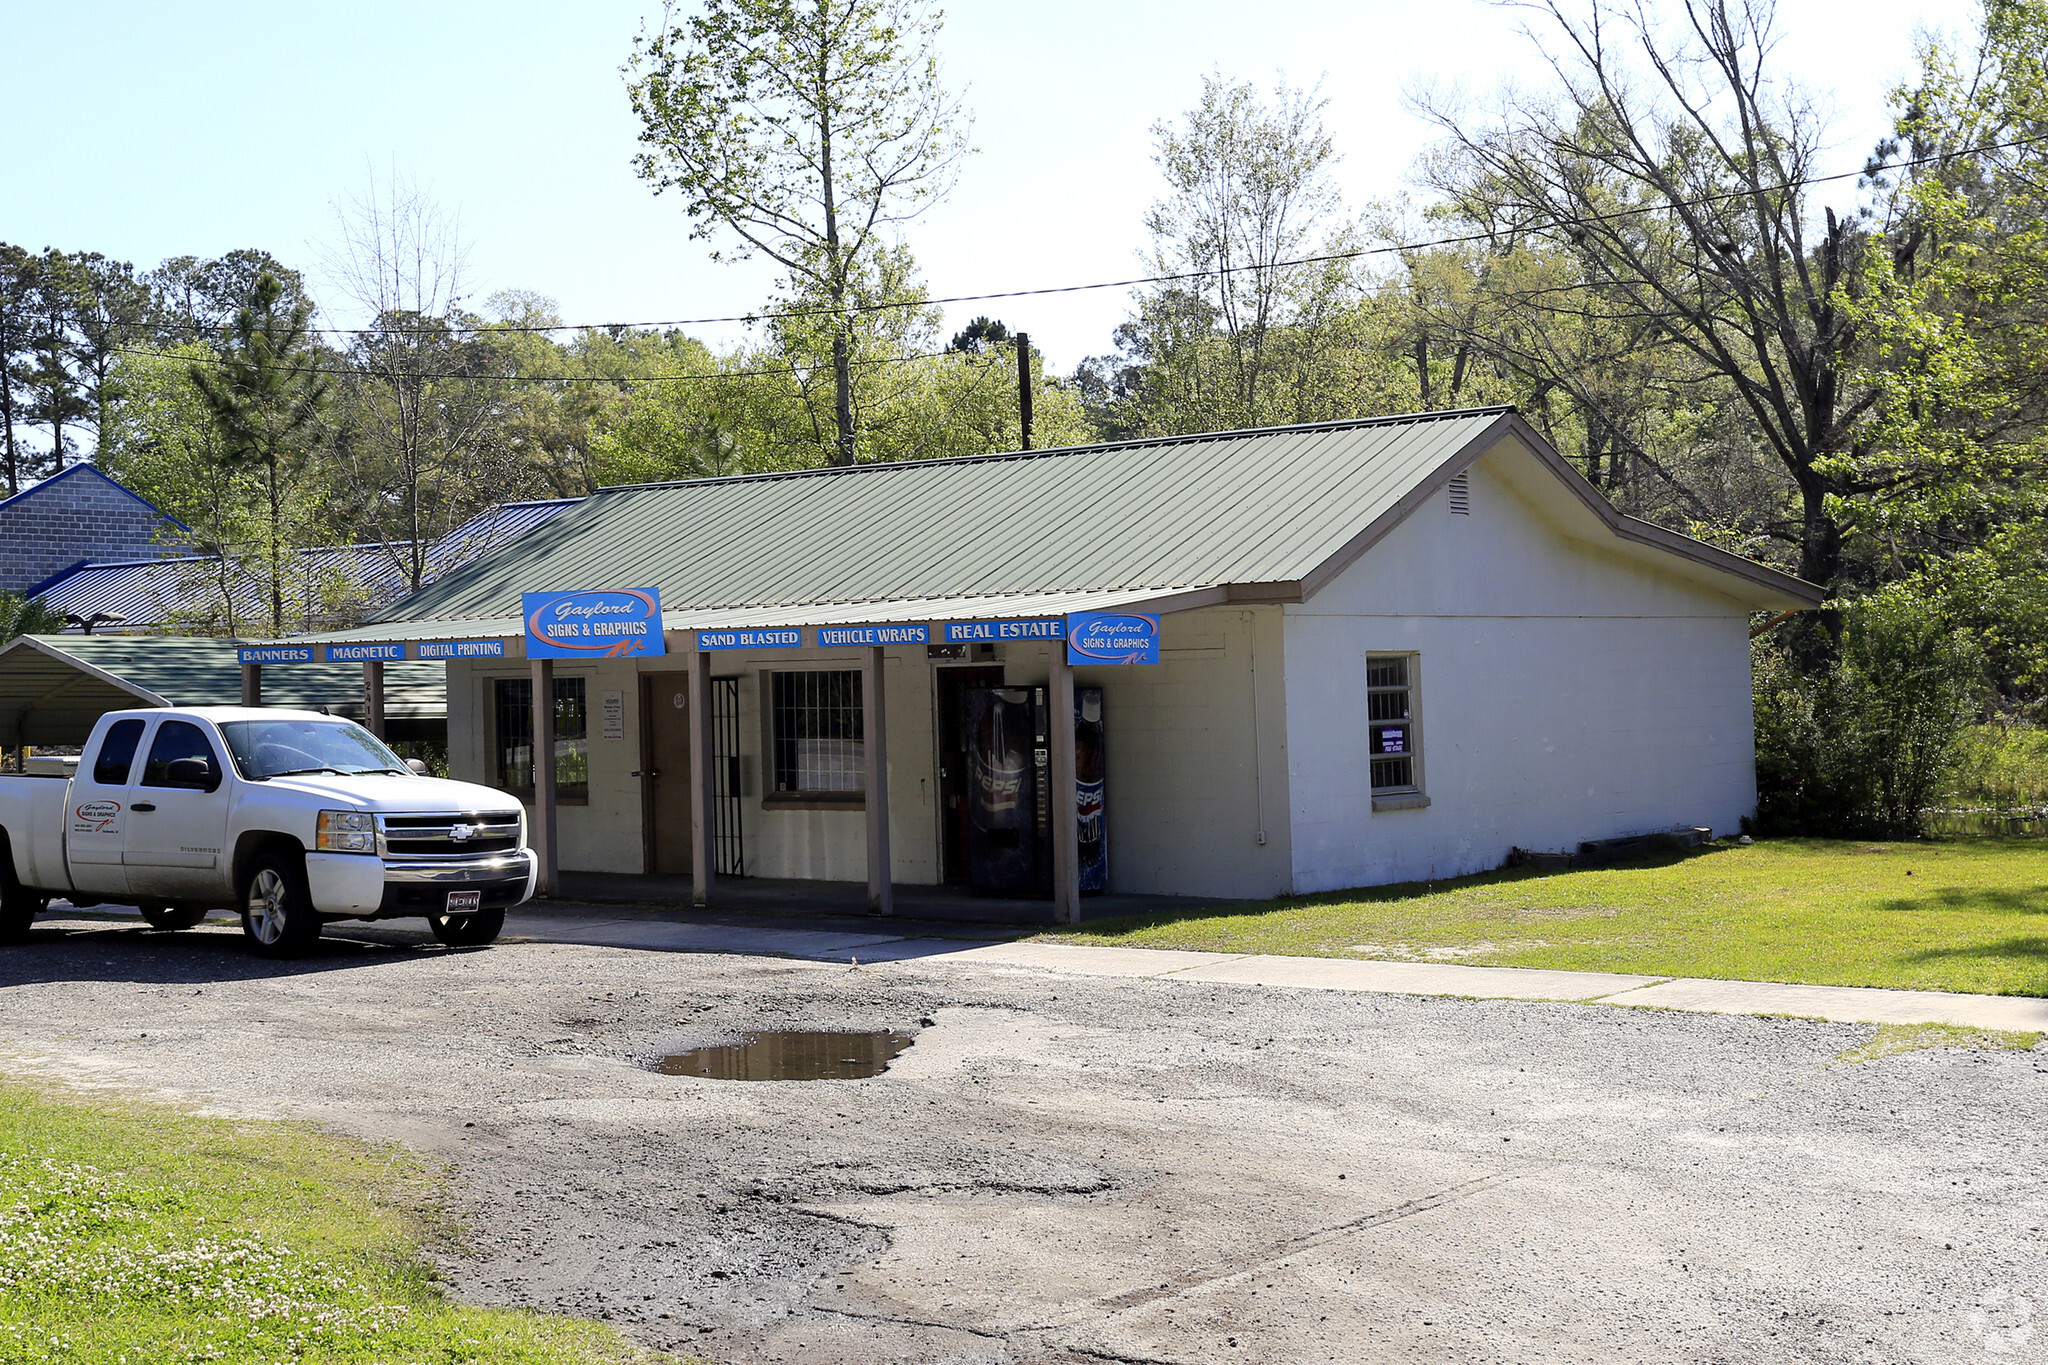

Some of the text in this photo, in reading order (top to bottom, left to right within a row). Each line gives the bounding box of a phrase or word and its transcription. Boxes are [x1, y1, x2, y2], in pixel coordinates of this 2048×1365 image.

[554, 600, 634, 622] Gaylord
[547, 621, 647, 637] SIGNS & GRAPHICS
[822, 628, 925, 644] VEHICLE WRAPS
[951, 622, 1060, 639] REAL ESTATE
[1088, 621, 1144, 637] Gaylord
[701, 632, 798, 647] SAND BLASTED
[1083, 638, 1149, 649] SIGNS & GRAPHICS
[243, 649, 309, 661] BANNERS
[333, 645, 398, 659] MAGNETIC
[420, 642, 501, 657] DIGITAL PRINTING
[974, 765, 1023, 795] PEPSI
[1075, 785, 1105, 807] EPSI
